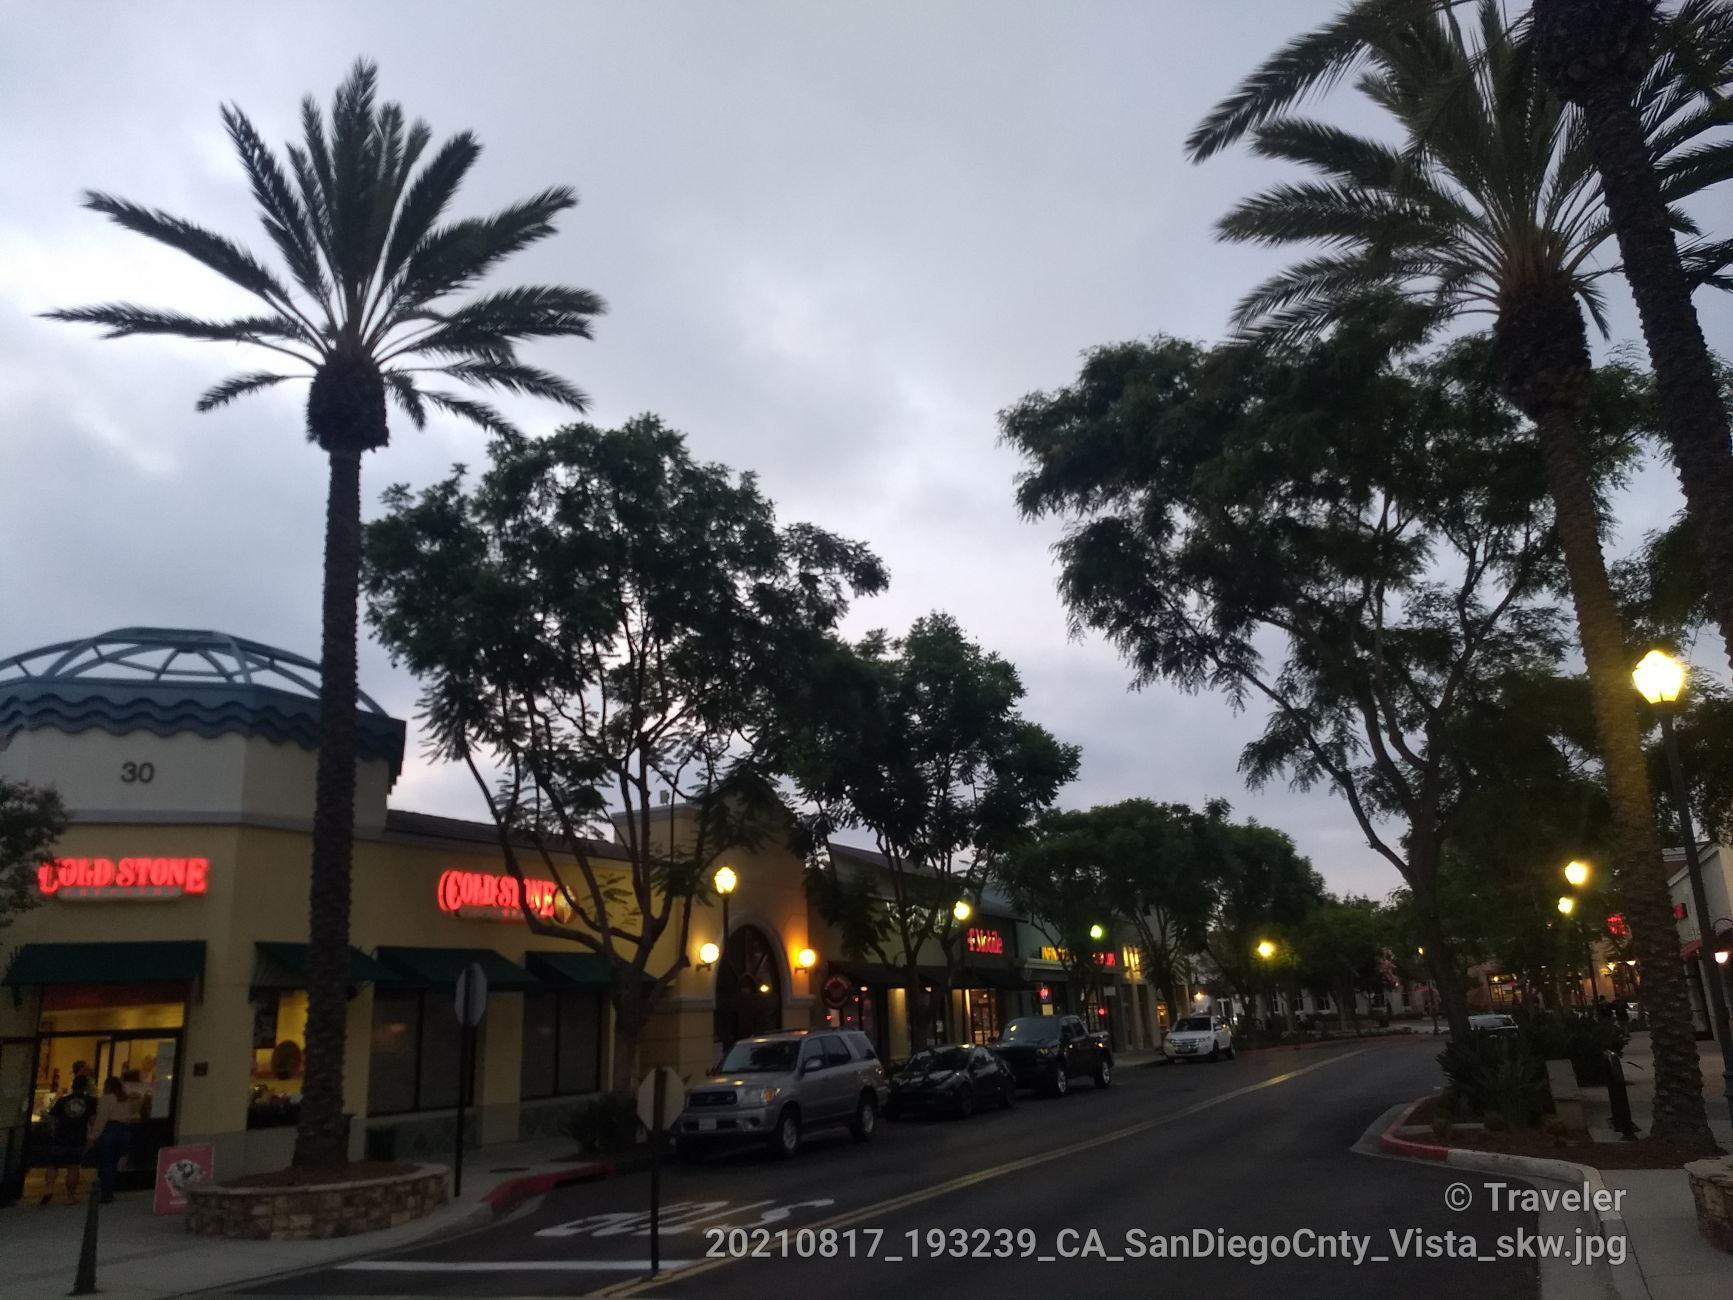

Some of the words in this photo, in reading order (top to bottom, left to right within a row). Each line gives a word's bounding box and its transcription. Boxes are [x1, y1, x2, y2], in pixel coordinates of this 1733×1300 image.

[121, 761, 155, 784] 30
[37, 857, 115, 894] COLD
[115, 857, 208, 893] STONE
[438, 869, 499, 911] COLD
